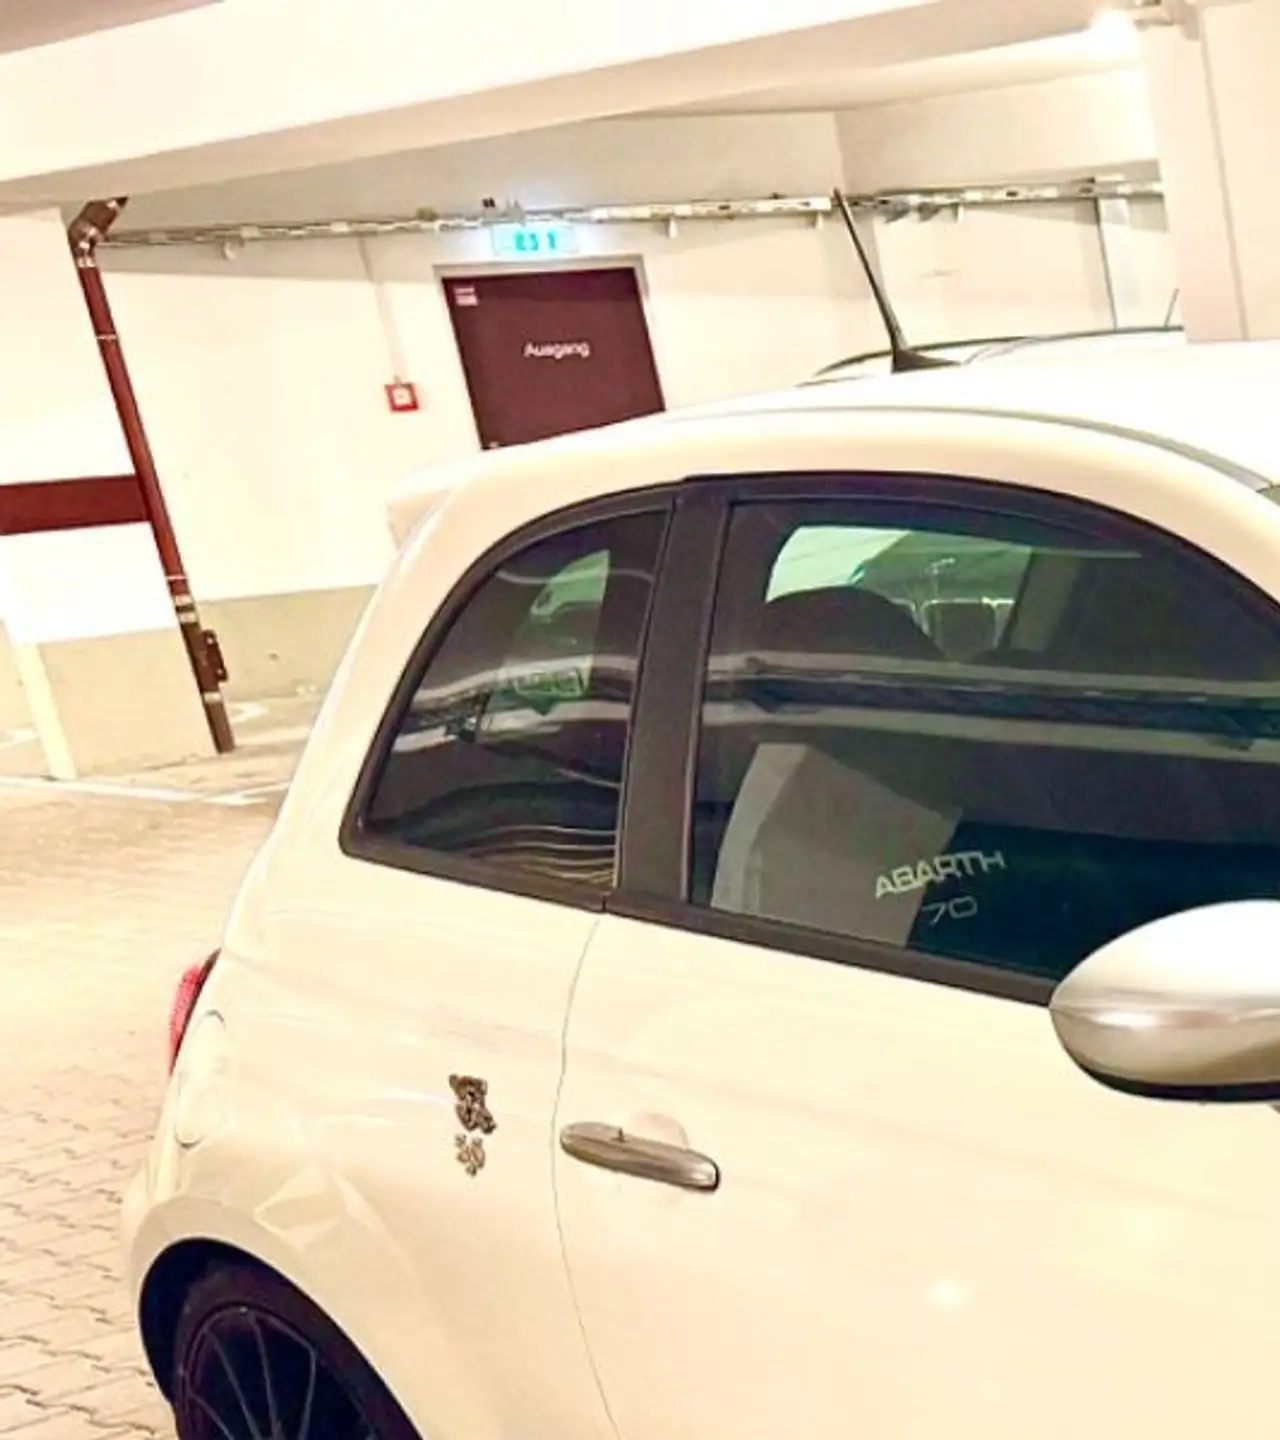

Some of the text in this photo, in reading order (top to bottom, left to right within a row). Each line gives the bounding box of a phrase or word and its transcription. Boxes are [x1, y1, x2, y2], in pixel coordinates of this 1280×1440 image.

[522, 341, 591, 360] Ausgang
[874, 848, 1007, 900] ABARTH
[921, 895, 979, 927] 70
